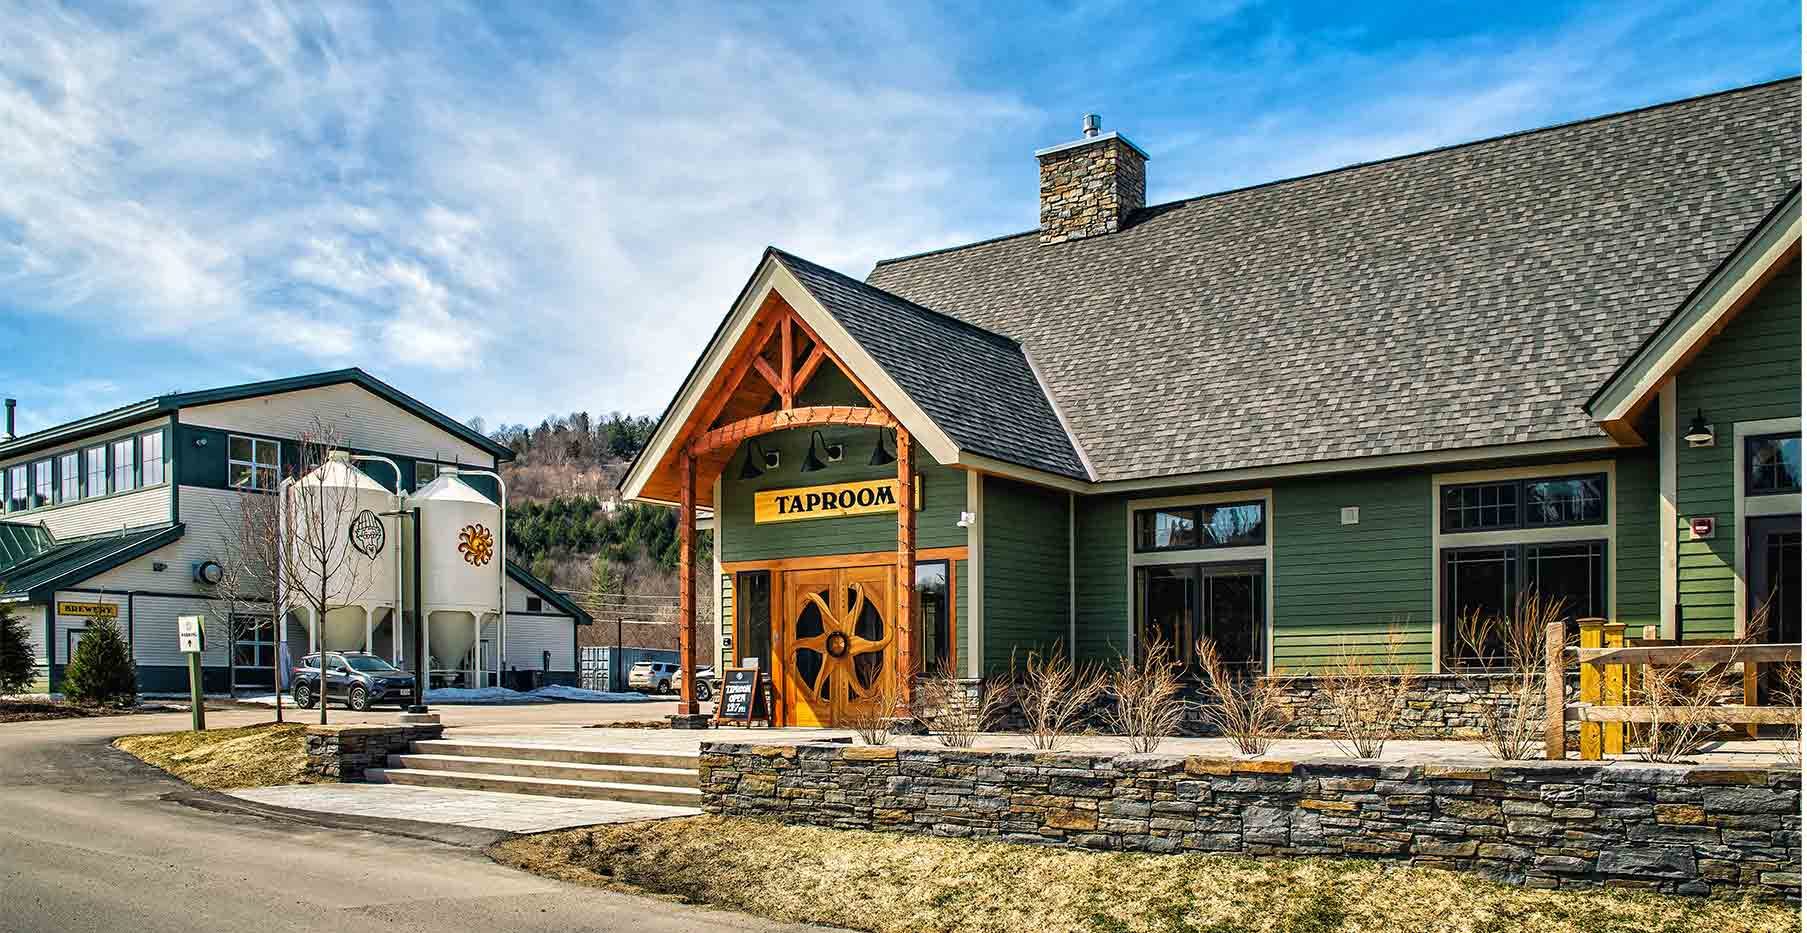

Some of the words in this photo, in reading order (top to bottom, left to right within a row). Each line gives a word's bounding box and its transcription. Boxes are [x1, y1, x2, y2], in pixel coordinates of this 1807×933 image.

[775, 486, 896, 514] TAPROOM
[64, 605, 112, 613] BREWERY
[728, 694, 746, 703] OPEN
